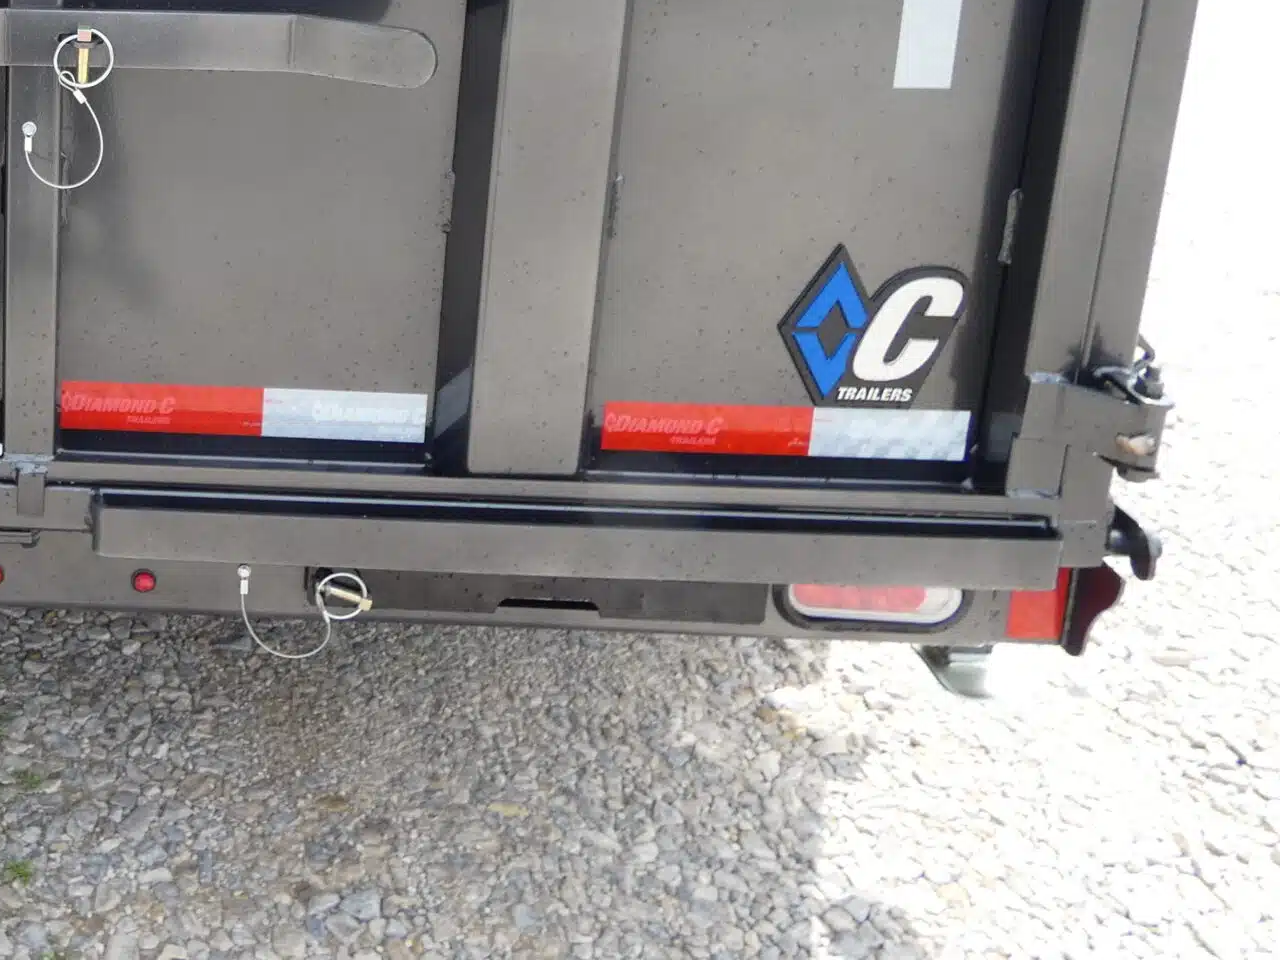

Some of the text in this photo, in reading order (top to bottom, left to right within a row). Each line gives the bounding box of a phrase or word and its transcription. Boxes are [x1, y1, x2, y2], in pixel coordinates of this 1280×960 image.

[853, 277, 964, 382] C
[73, 393, 176, 415] DIAMOND C
[836, 386, 913, 402] TRAILERS
[618, 414, 725, 435] DIAMOND C
